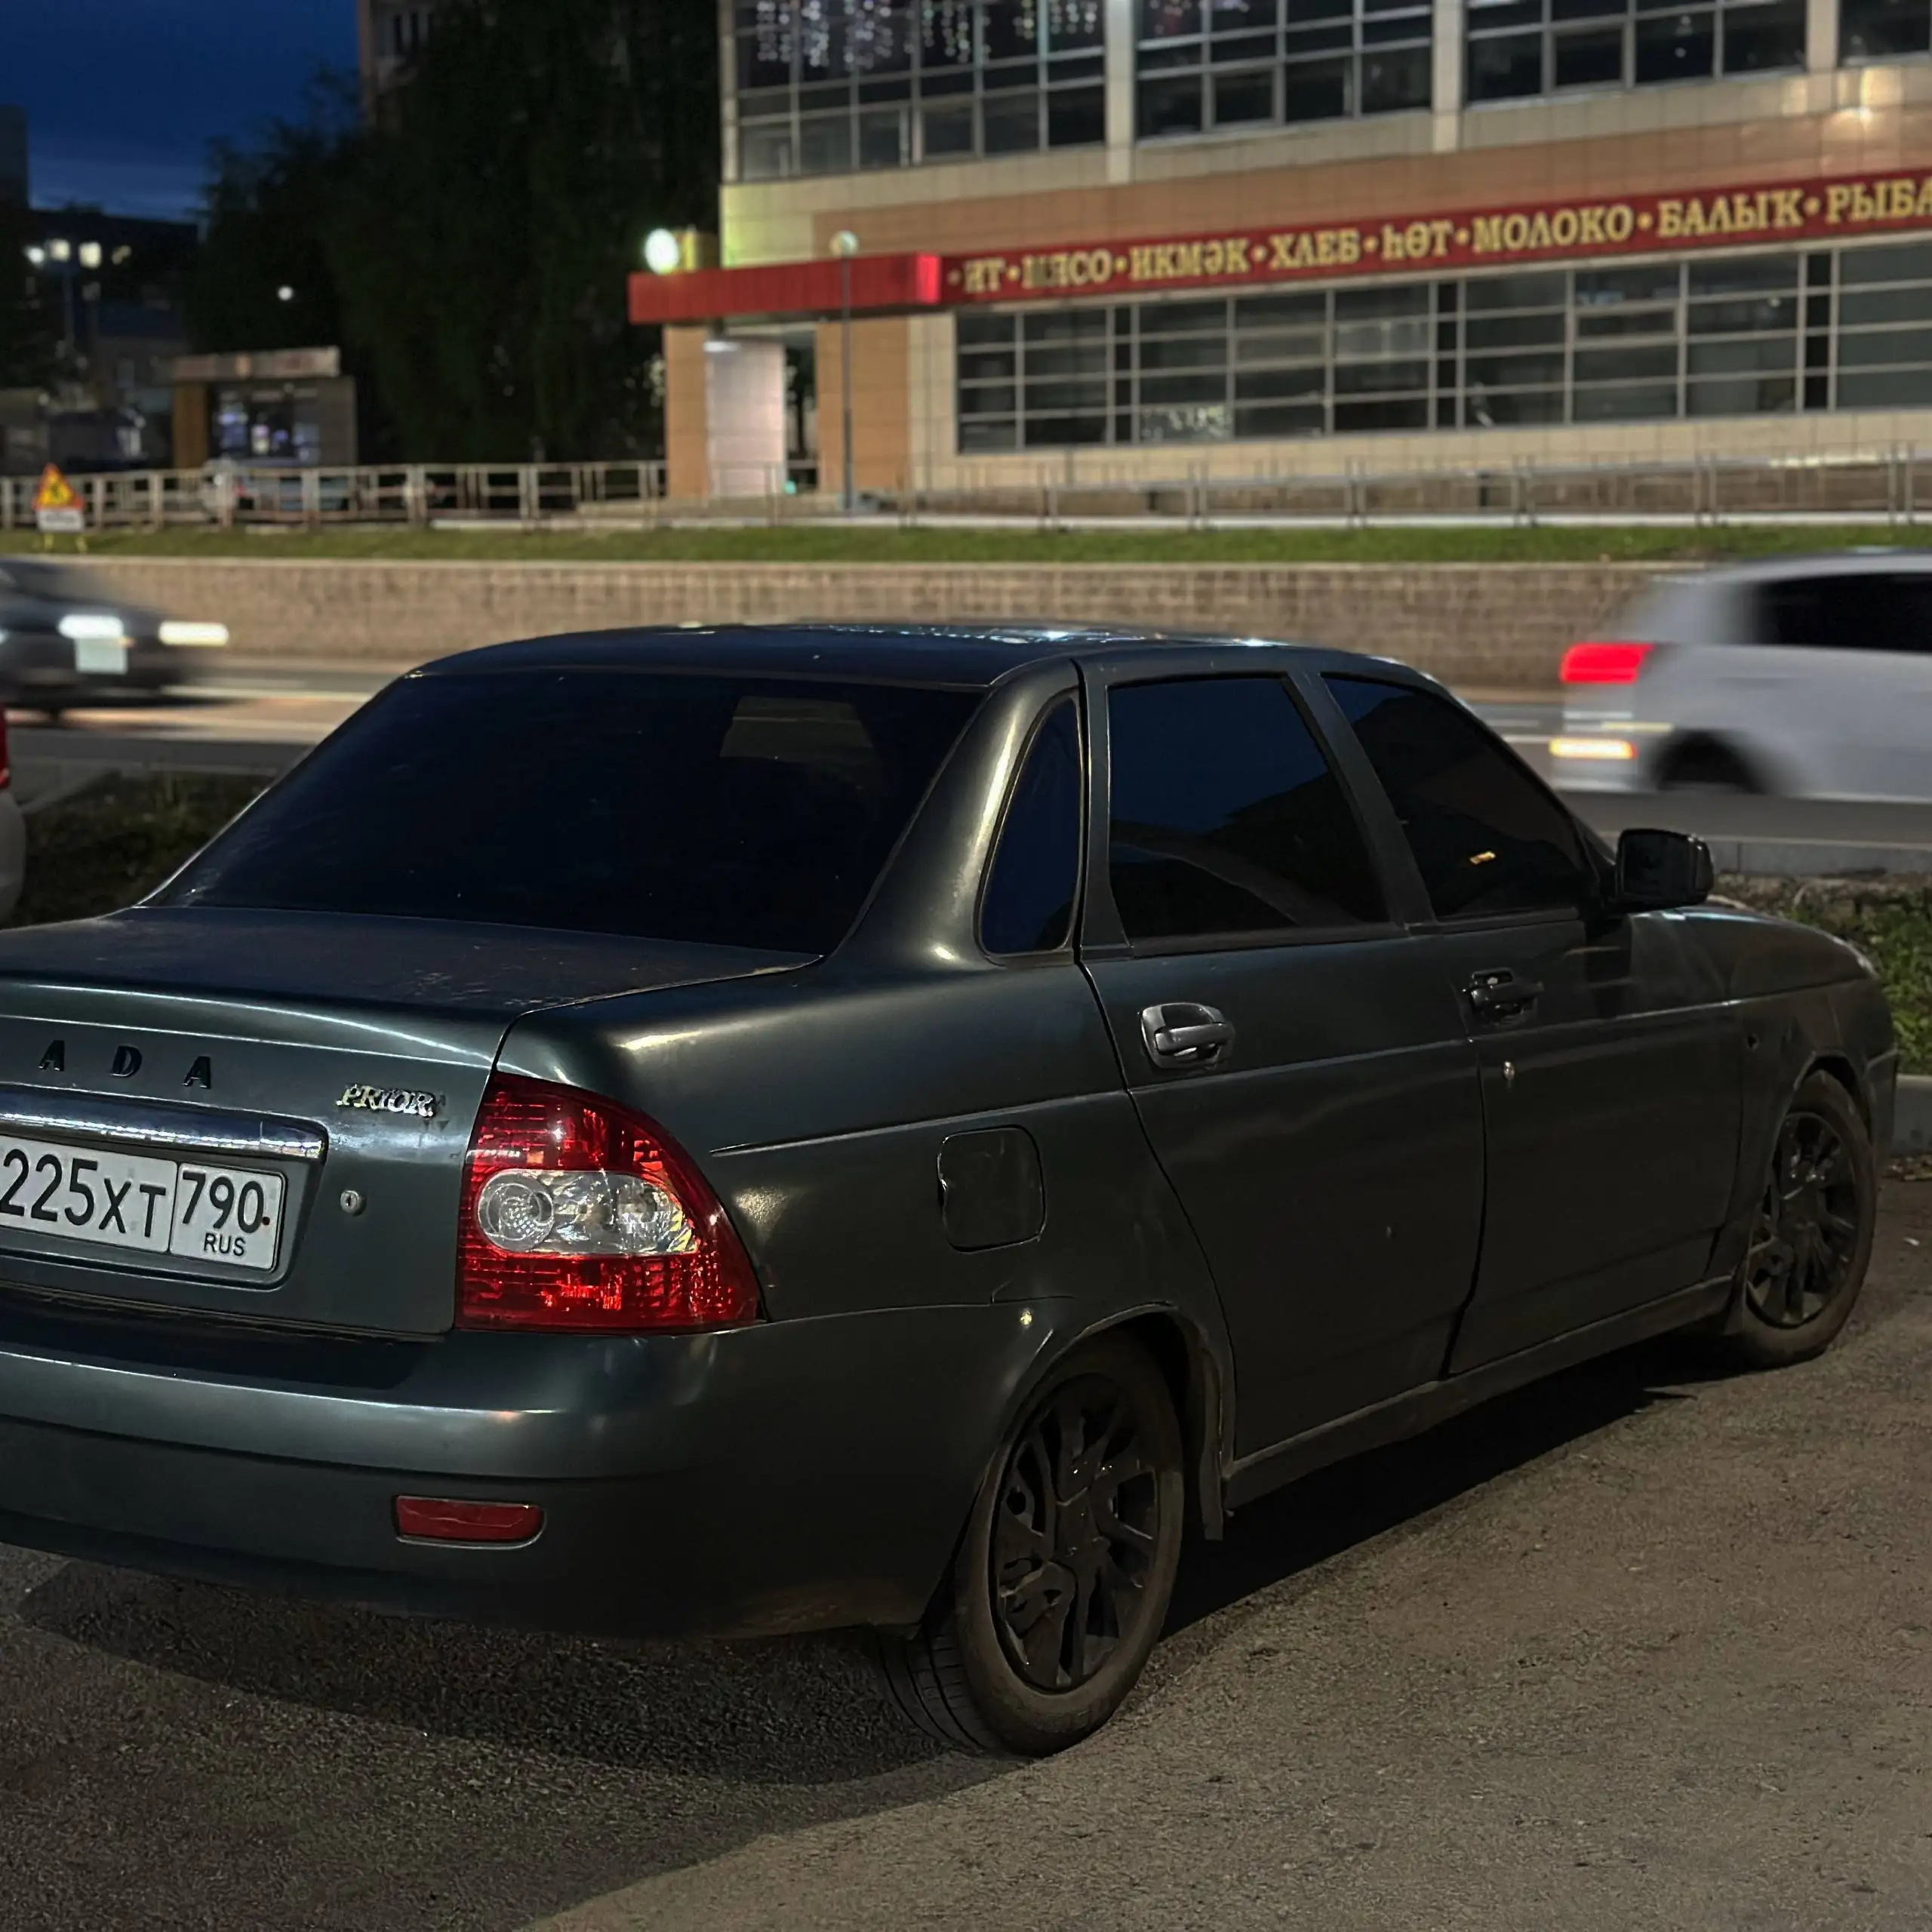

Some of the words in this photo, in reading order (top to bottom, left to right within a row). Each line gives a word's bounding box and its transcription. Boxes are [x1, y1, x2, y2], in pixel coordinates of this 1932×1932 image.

[1268, 228, 1360, 270] ХЛЕБ
[1472, 205, 1634, 253] МОЛОКО
[1825, 176, 1932, 226] РЫБА
[183, 1171, 264, 1233] 790
[204, 1232, 246, 1257] RUS
